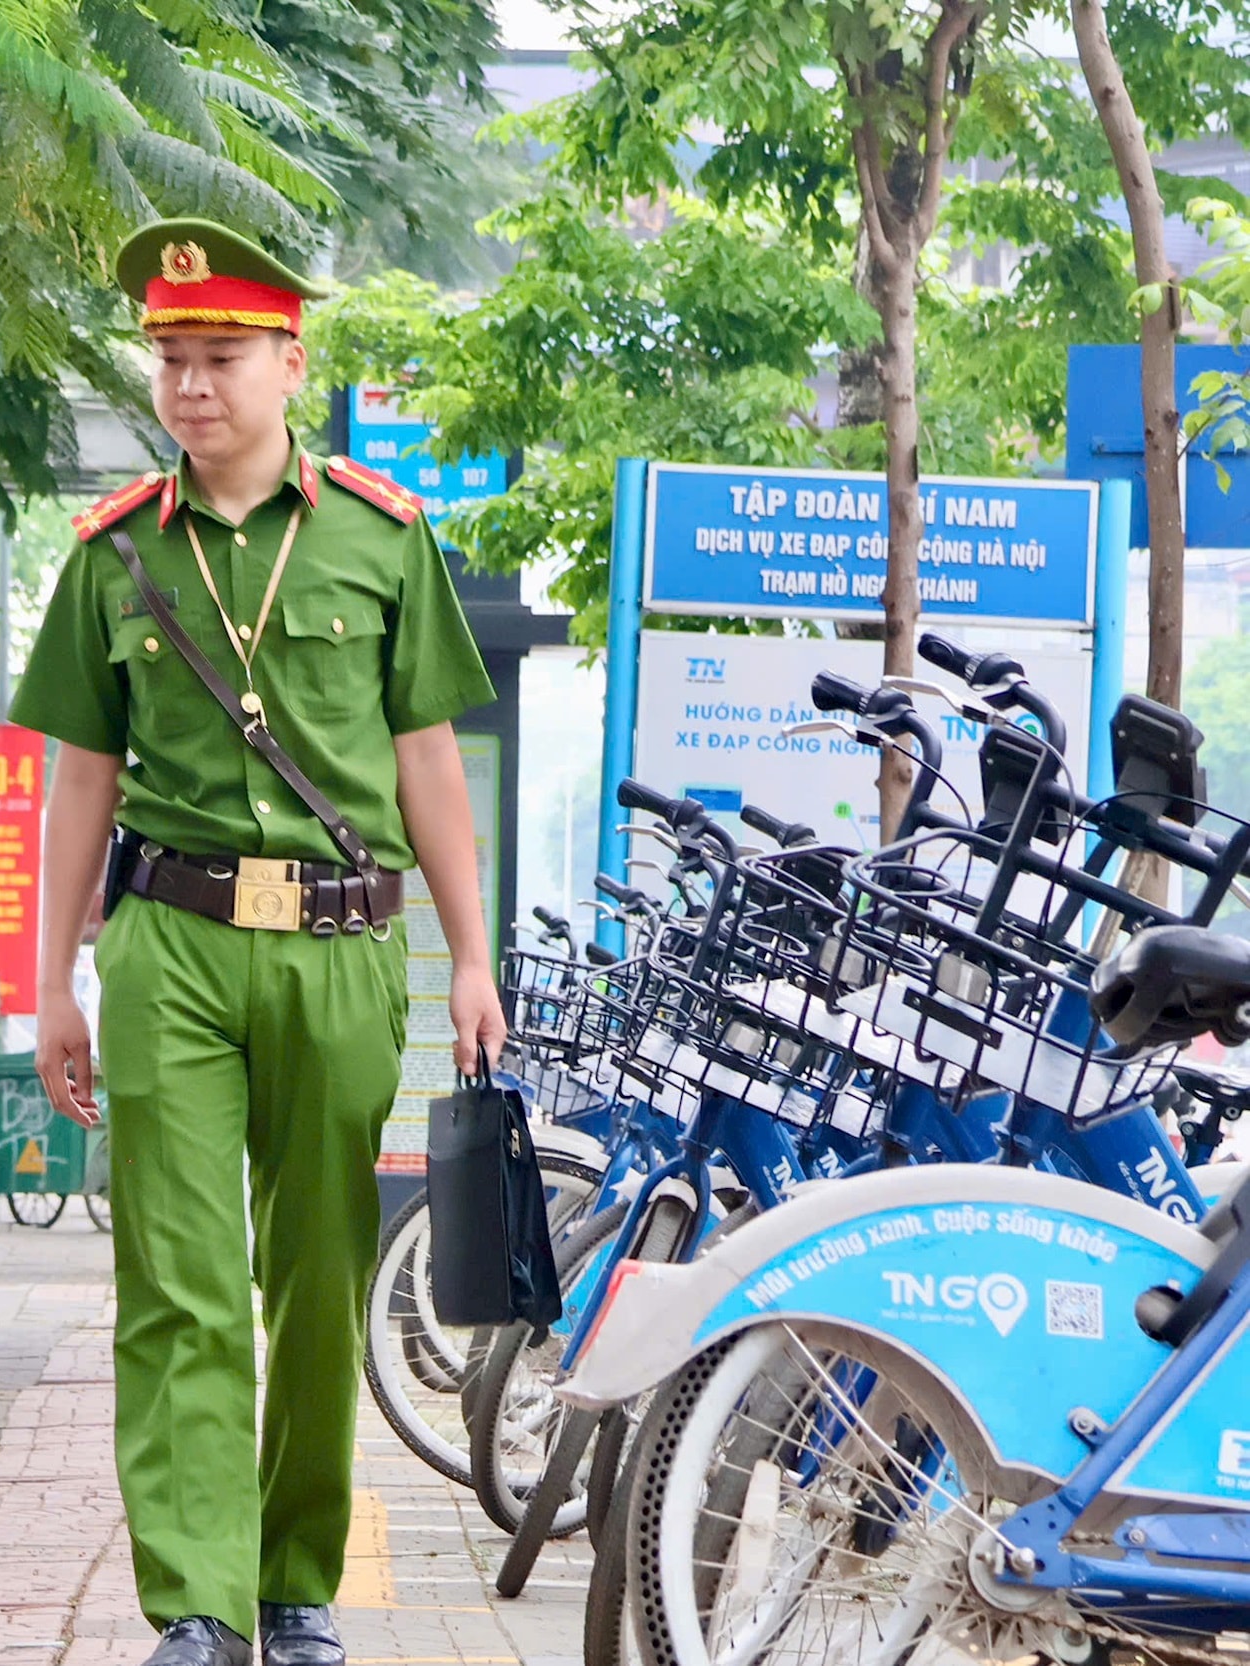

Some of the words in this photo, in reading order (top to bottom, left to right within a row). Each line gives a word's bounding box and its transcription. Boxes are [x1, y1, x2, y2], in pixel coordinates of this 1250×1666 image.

[730, 481, 787, 522] TẬP
[795, 485, 880, 522] ĐOÀN
[945, 497, 1017, 529] NAM
[695, 528, 743, 557] DỊCH
[749, 530, 774, 559] VỤ
[780, 532, 805, 557] XE
[810, 533, 851, 562] ĐẠP
[978, 538, 1005, 566] HÀ
[1010, 539, 1046, 572] NỘI
[760, 570, 816, 597] TRẠM
[820, 563, 847, 596] HỒ
[686, 657, 726, 678] TN
[685, 701, 762, 722] HƯỚNG
[769, 701, 813, 724] DẪN
[676, 731, 699, 748] XE
[708, 733, 750, 754] ĐẠP
[933, 1206, 991, 1236] Cuộc
[996, 1208, 1051, 1242] sống
